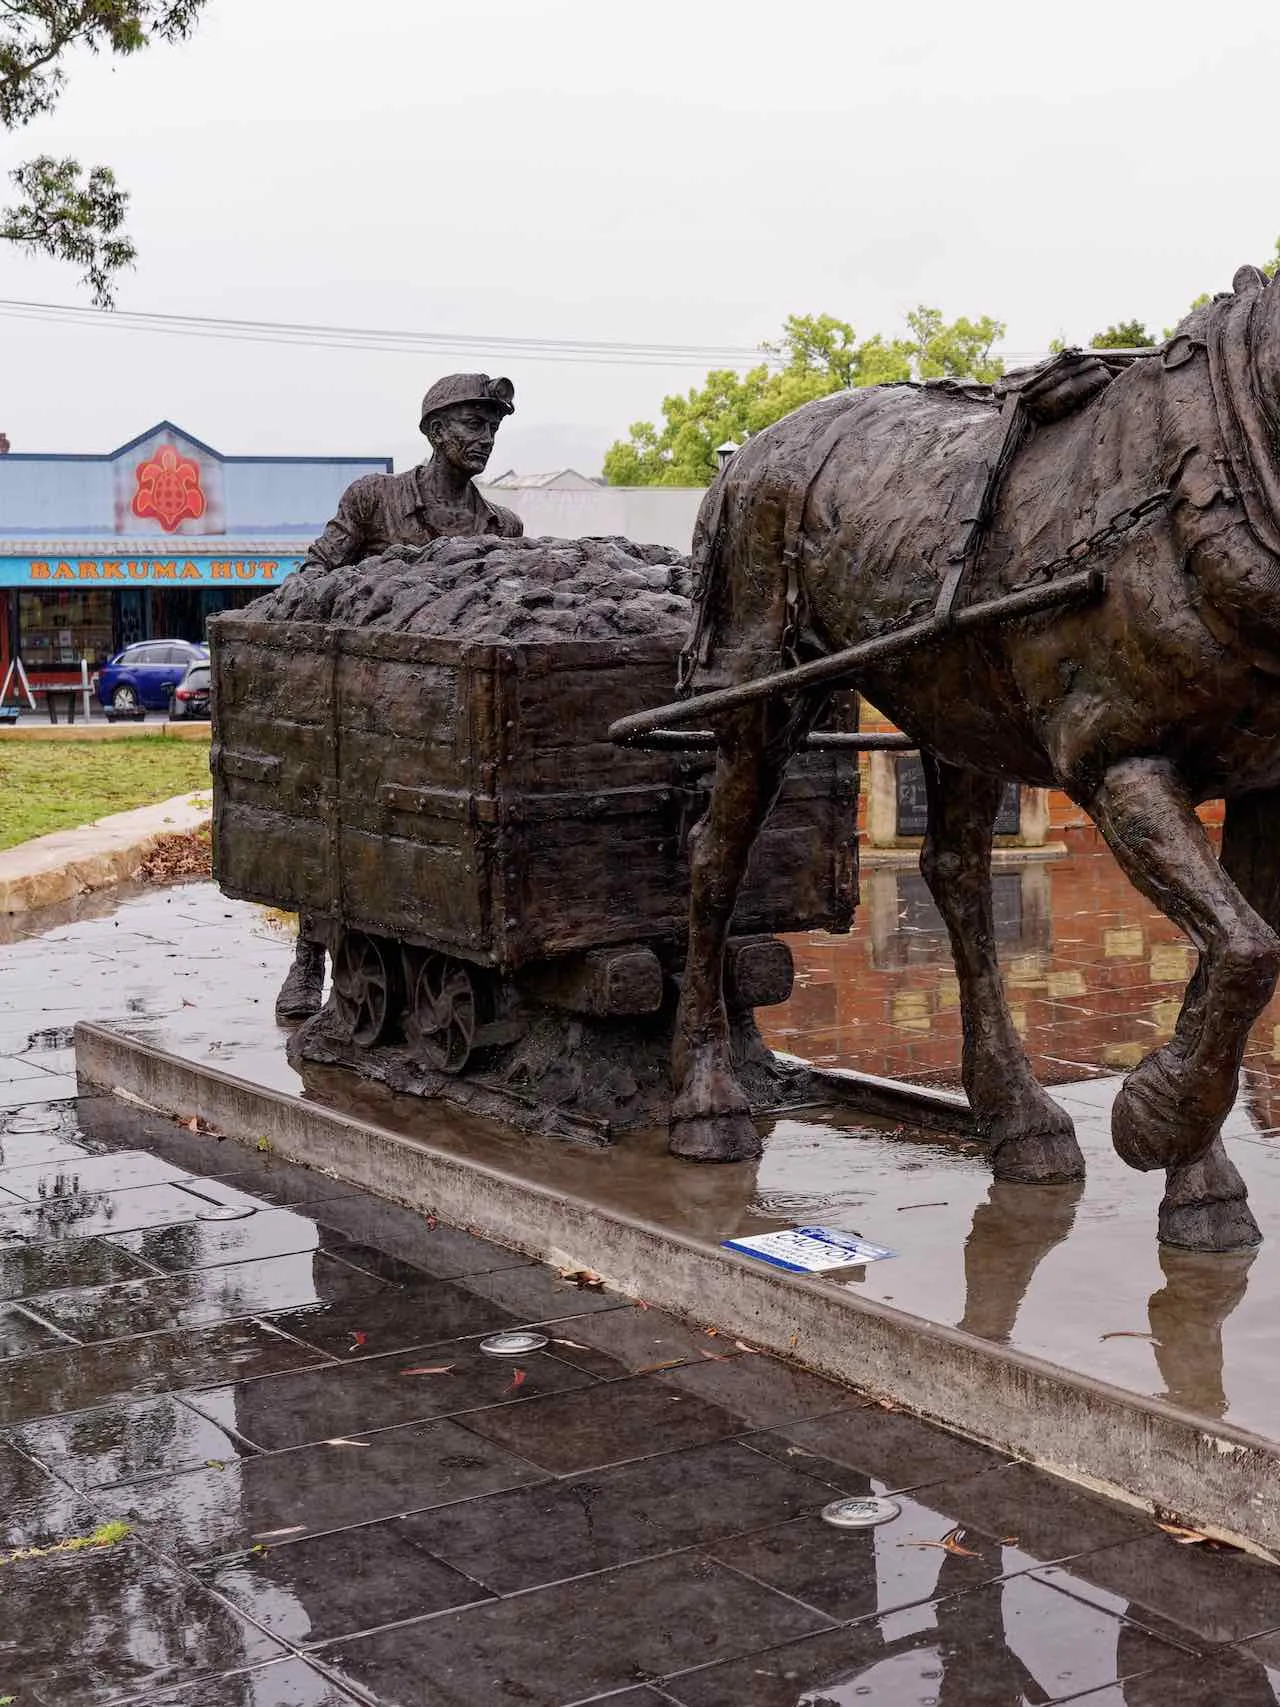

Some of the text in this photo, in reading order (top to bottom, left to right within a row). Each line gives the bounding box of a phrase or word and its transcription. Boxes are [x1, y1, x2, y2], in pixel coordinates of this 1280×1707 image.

[30, 560, 278, 580] BARKUMA HUT
[776, 1234, 856, 1262] CAUTION
